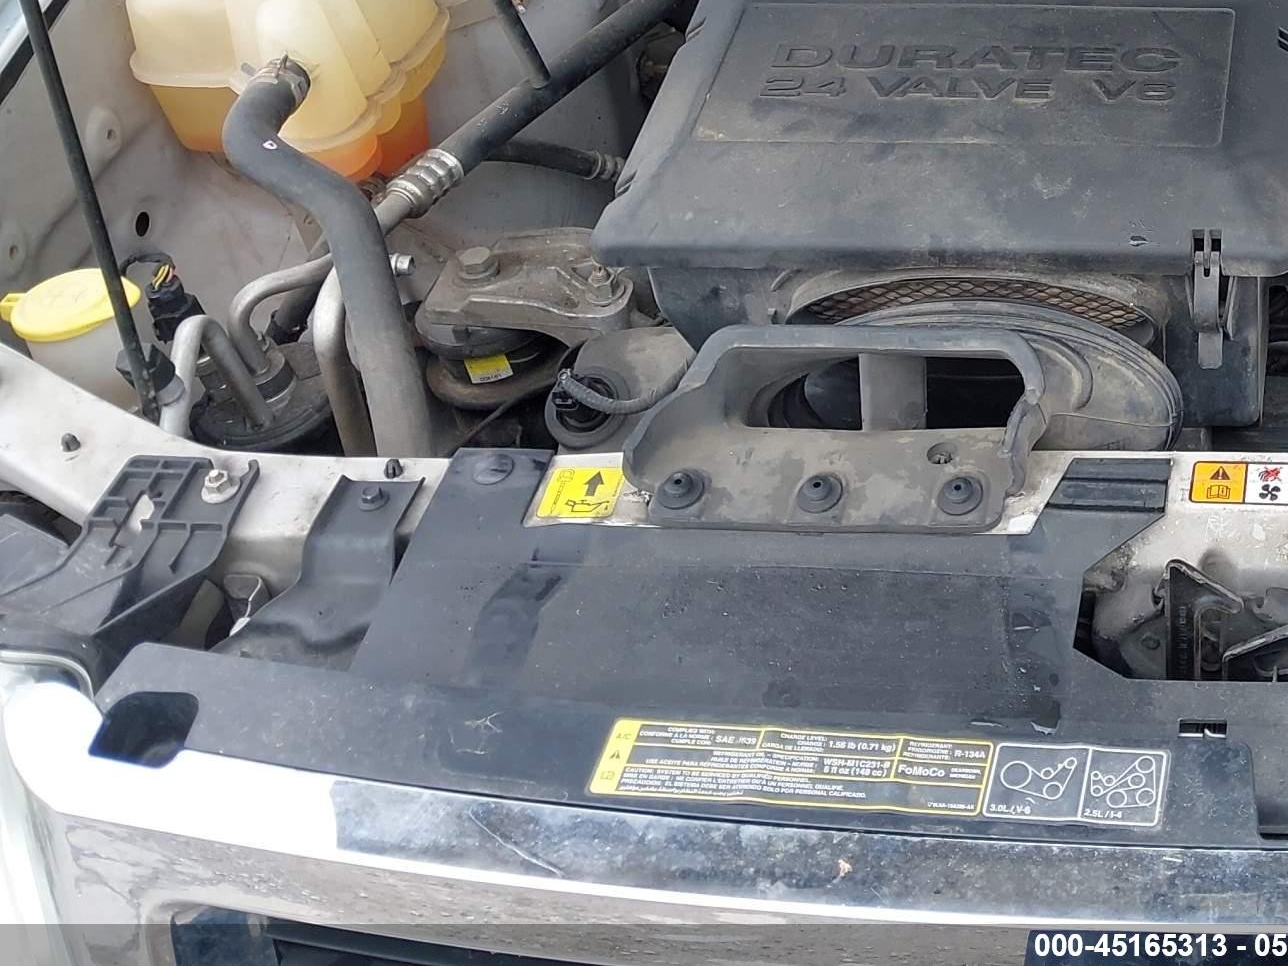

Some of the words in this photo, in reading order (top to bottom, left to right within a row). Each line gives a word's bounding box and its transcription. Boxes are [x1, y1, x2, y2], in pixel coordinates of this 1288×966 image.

[769, 43, 1183, 73] DURATEC
[759, 75, 848, 99] 24
[866, 75, 1057, 101] VALVE
[1092, 77, 1178, 102] V6
[715, 735, 734, 744] SAE
[847, 742, 856, 750] lb
[857, 742, 879, 752] (0.71
[881, 743, 896, 754] kg)
[954, 749, 986, 759] R-134A
[871, 769, 887, 777] cc)
[898, 764, 945, 778] FoMoCo
[989, 804, 1010, 813] 3.0L
[1016, 806, 1031, 814] V-6
[1084, 808, 1103, 817] 2.5L
